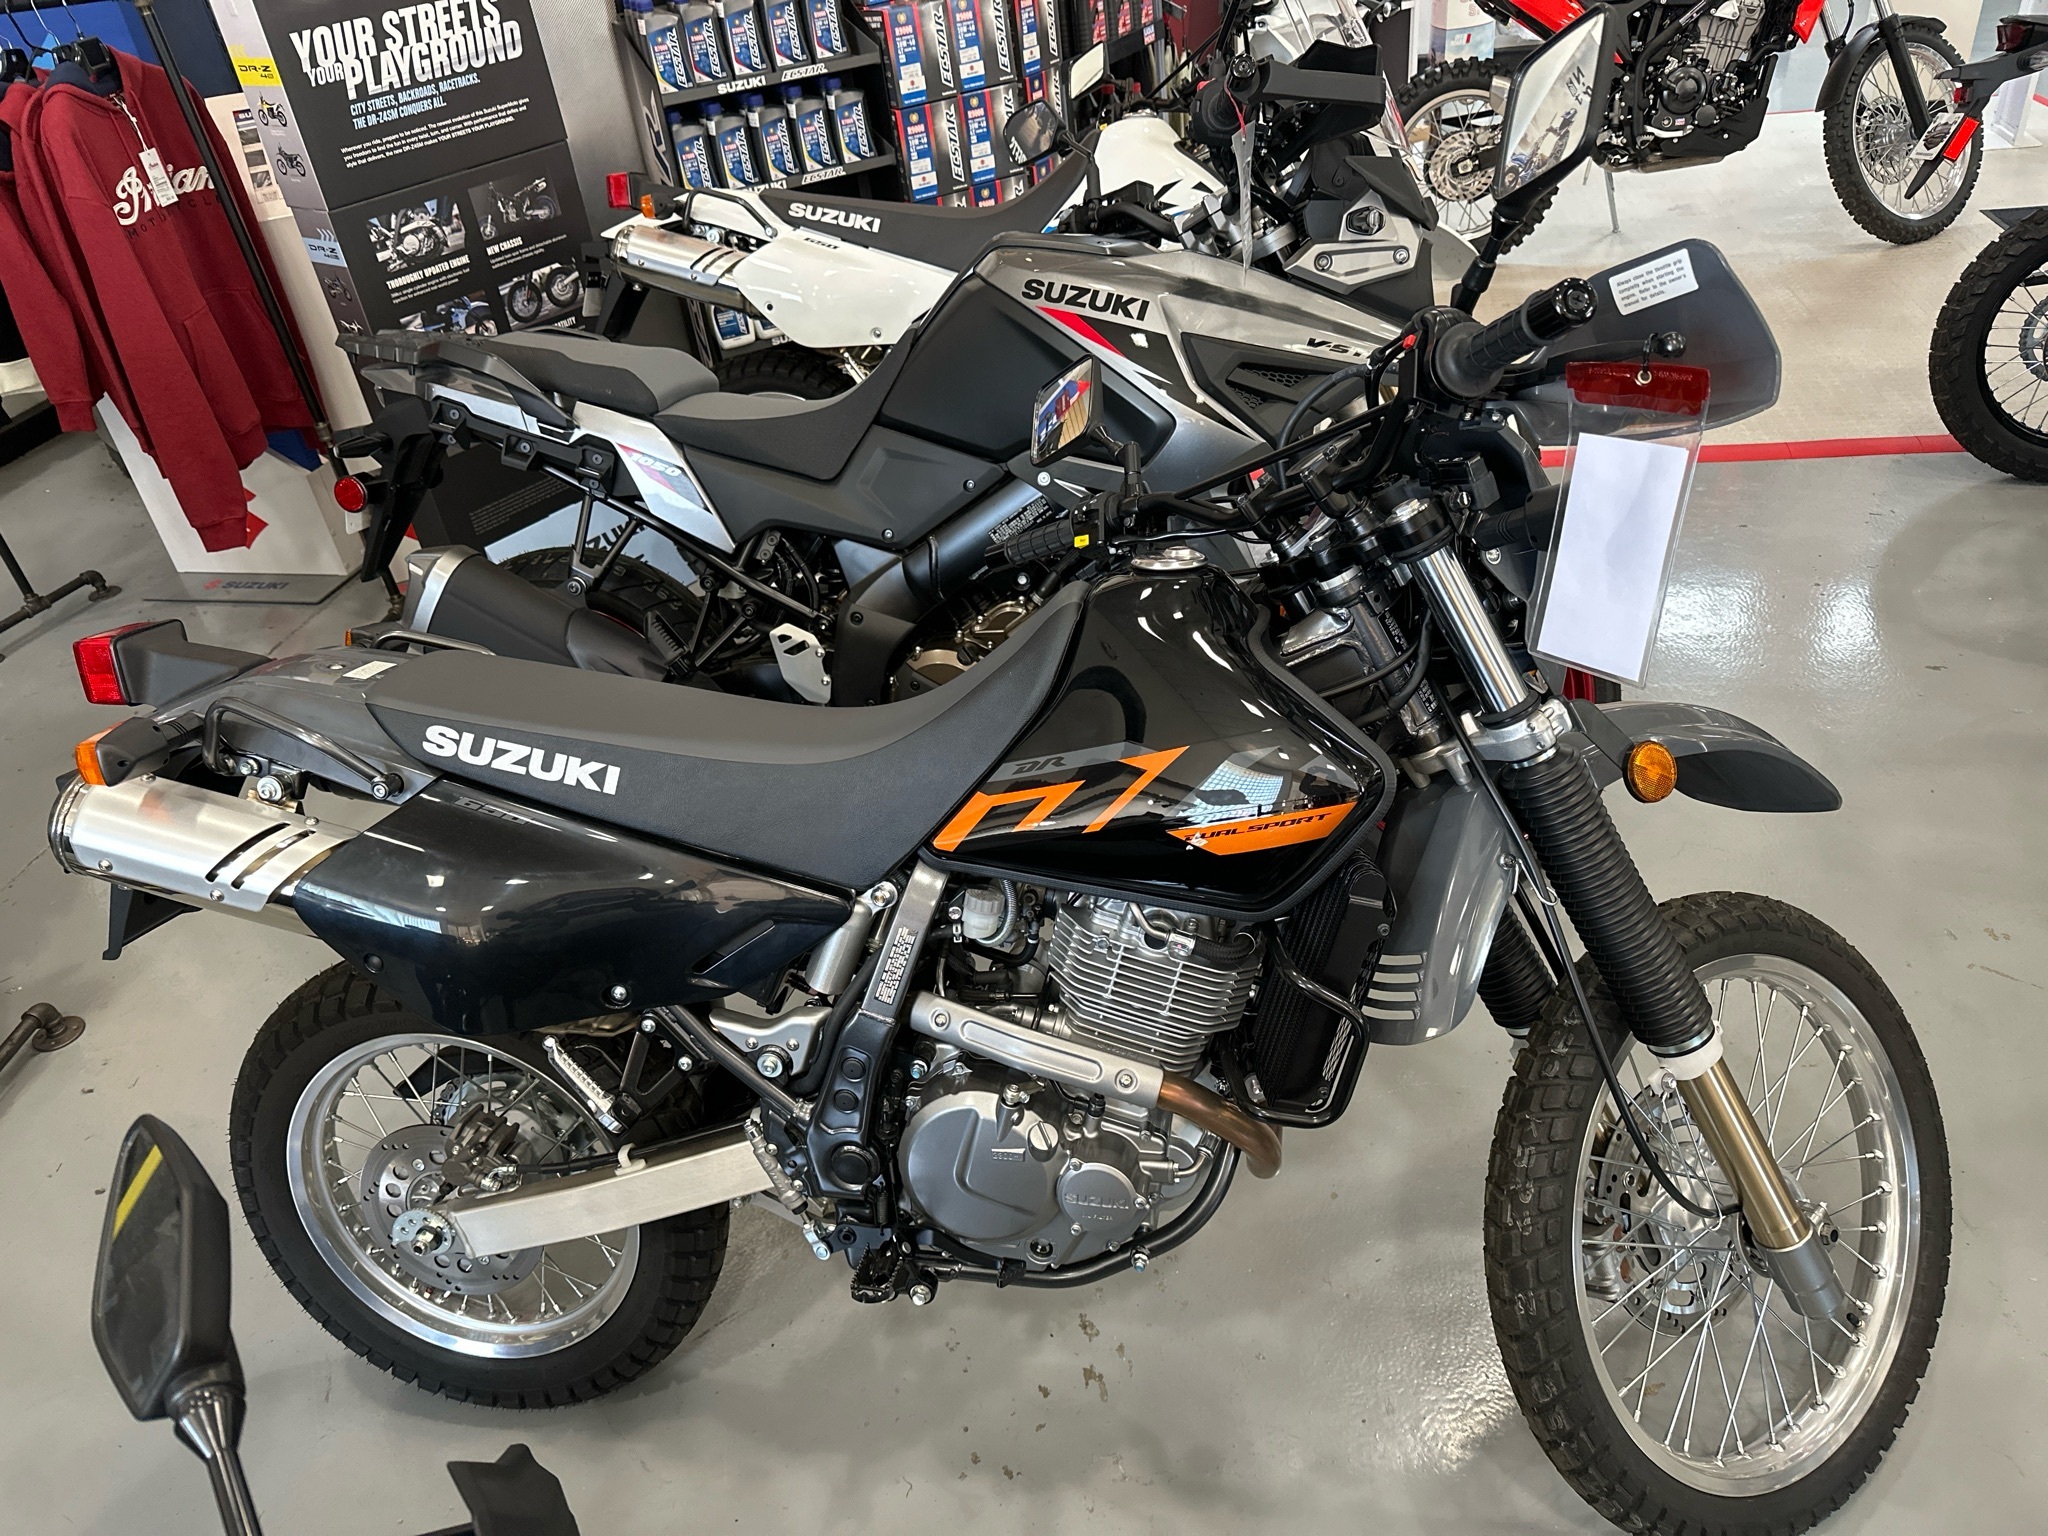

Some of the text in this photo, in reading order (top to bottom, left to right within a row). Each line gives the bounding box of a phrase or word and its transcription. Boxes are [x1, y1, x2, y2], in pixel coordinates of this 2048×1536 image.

[289, 0, 501, 73] YOUR STREETS
[667, 27, 688, 88] ECSTAR
[702, 19, 722, 78] ECSTAR
[743, 10, 762, 70] ECSTAR
[784, 2, 802, 61] ECSTAR
[932, 4, 954, 88] ECSTAR
[992, 0, 1011, 73] ECSTAR
[307, 20, 523, 100] YOUR PLAYGROUND
[717, 75, 766, 95] SUZUKI
[782, 63, 828, 82] ECSTAR
[350, 73, 480, 116] CITY STREETS, BACKROADS, RACETRACKS.
[352, 95, 447, 130] THE DR-Z4SM CONQUERS ALL.
[736, 127, 755, 183] ECSTAR
[778, 119, 795, 174] ECSTAR
[815, 110, 832, 165] ECSTAR
[853, 102, 871, 157] ECSTAR
[943, 103, 965, 182] ECSTAR
[802, 166, 846, 185] ECSTAR
[788, 202, 881, 233] SUZUKI
[386, 254, 471, 290] THOROUGHLY UPDATED ENGINE
[486, 236, 523, 256] NEW CHASSIS
[1022, 278, 1150, 322] SUZUKI
[222, 581, 290, 590] SUZUKI
[422, 724, 621, 796] SUZUKI
[1011, 756, 1067, 776] DR
[1247, 812, 1332, 833] SPORT
[1065, 1193, 1129, 1210] SUZUKI
